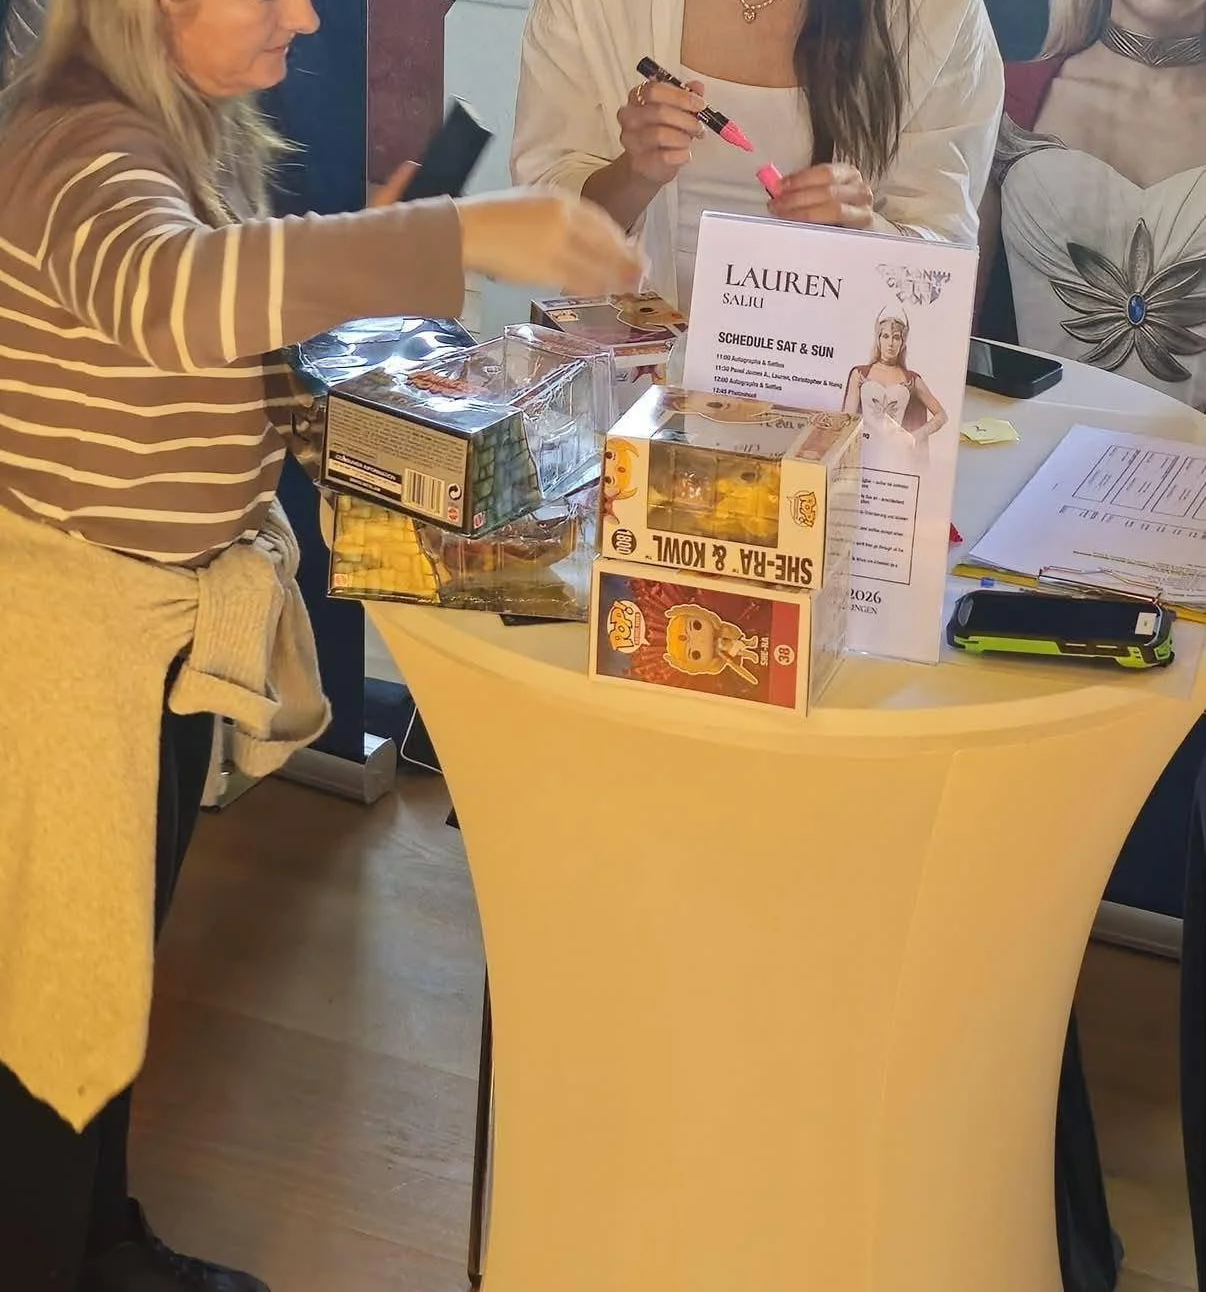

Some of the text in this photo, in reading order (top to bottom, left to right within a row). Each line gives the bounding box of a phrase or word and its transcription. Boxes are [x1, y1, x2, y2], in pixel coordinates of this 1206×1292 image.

[725, 264, 843, 300] LAUREN
[722, 292, 764, 309] SALIU
[718, 331, 834, 358] SCHEDULE SAT & SUN
[652, 534, 814, 585] SHE-RA & KOWL
